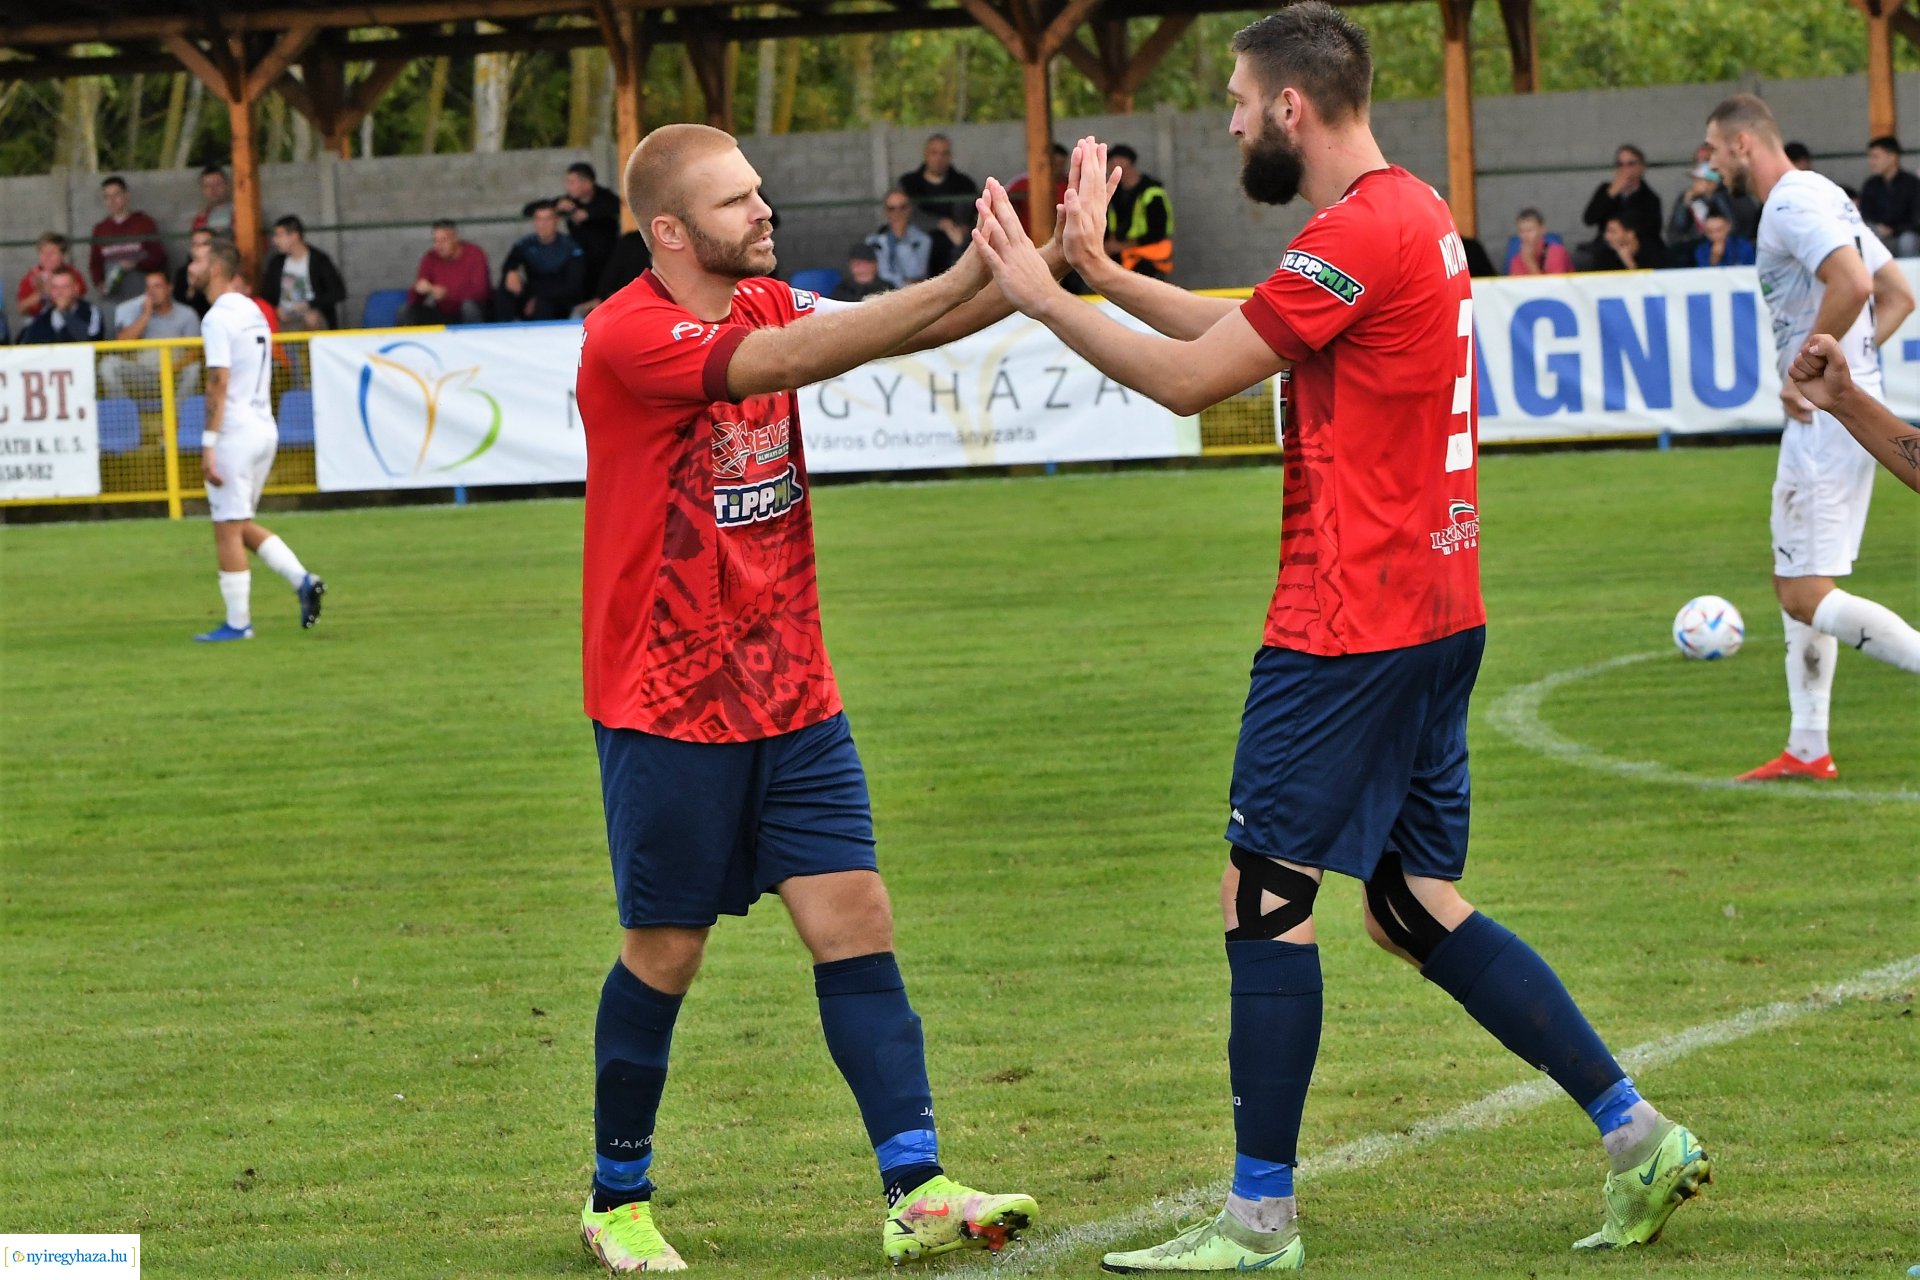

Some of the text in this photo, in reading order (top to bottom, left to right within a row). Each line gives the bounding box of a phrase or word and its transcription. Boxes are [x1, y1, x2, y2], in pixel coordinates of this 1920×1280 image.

[256, 336, 266, 394] 7
[21, 369, 87, 421] BT.
[805, 431, 865, 450] Város
[871, 427, 1037, 448] Önkormányzata
[609, 1134, 653, 1149] JAKO
